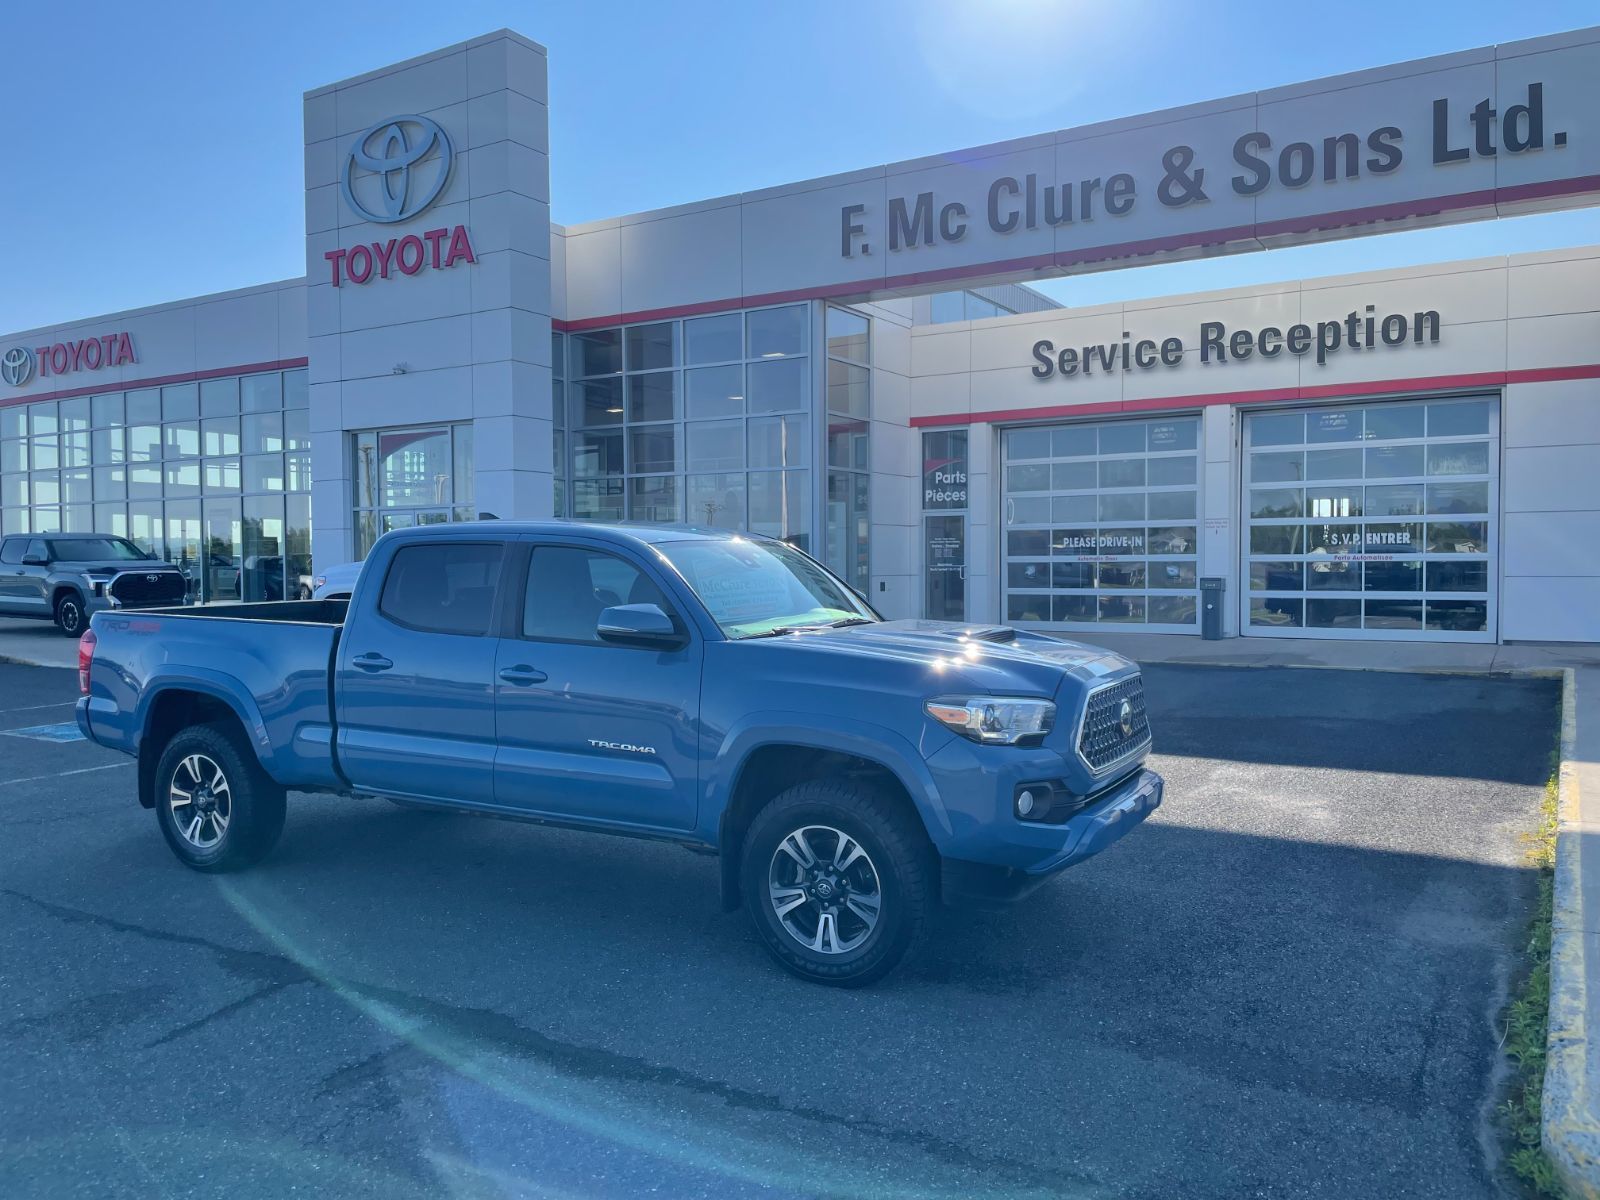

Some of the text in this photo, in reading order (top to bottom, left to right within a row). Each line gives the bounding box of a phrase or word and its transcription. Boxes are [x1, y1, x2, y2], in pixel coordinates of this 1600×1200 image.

[841, 82, 1568, 257] F. Mc Clure & Sons Ltd.
[324, 224, 475, 287] TOYOTA
[1031, 304, 1442, 379] Service Reception
[35, 331, 135, 377] TOYOTA
[935, 470, 967, 484] Parts
[925, 488, 967, 502] Pièces
[1063, 535, 1143, 548] PLEASE DRIVE-IN
[1330, 532, 1411, 545] S.V.P. ENTRER
[588, 739, 656, 754] TACOMA
